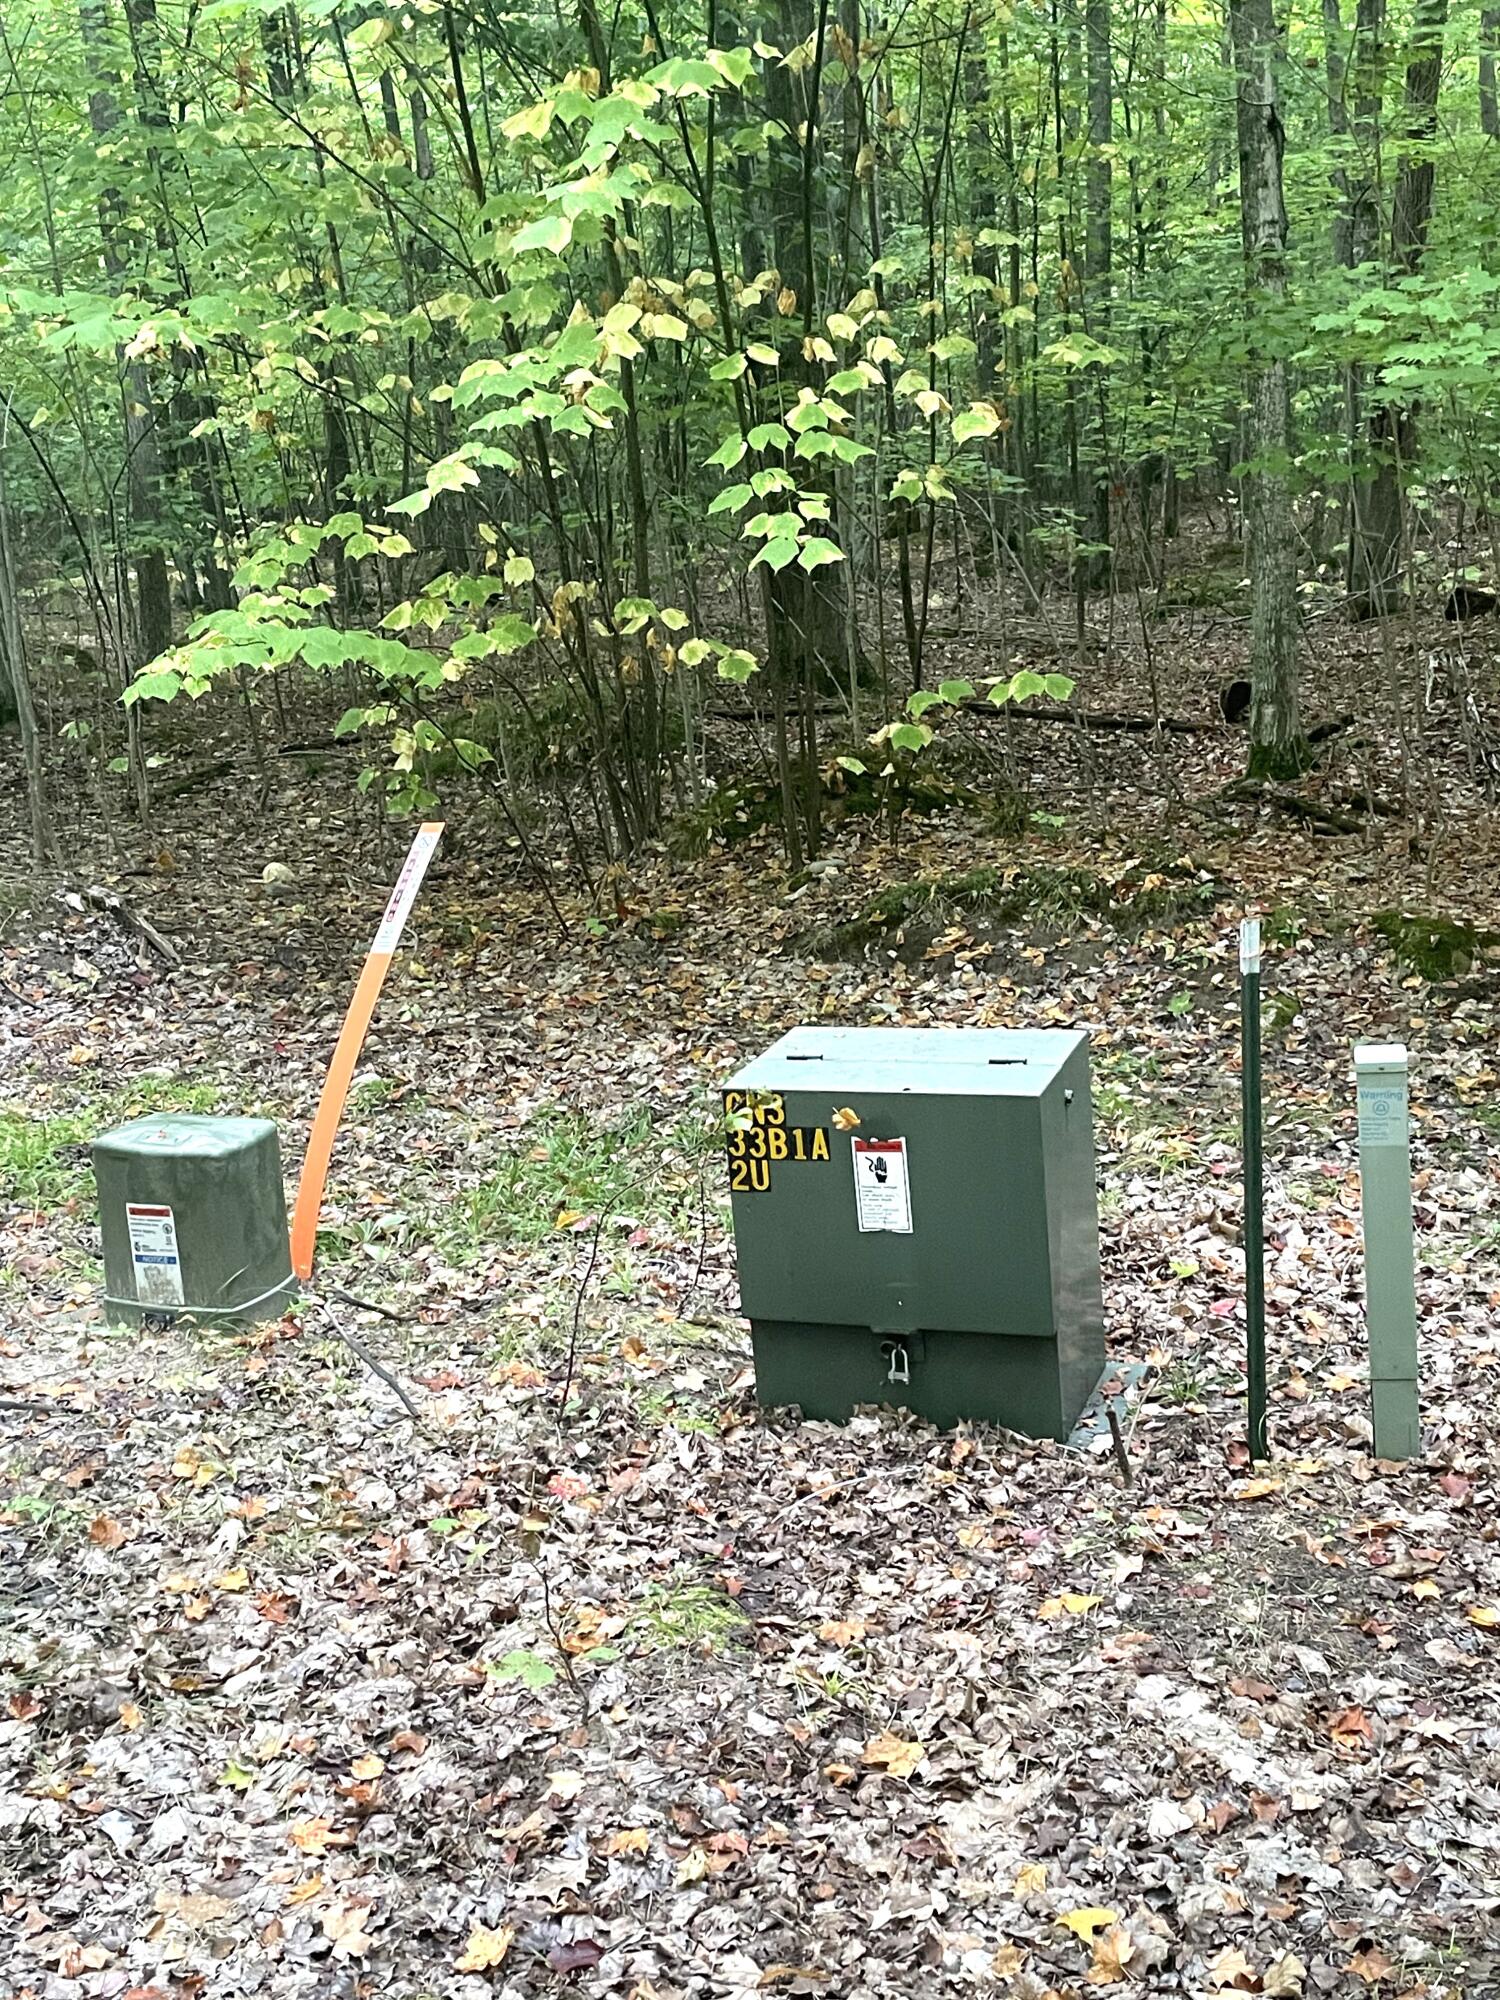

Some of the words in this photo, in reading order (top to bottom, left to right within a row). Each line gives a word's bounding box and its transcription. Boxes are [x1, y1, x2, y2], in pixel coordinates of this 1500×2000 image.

[1360, 1091, 1403, 1101] Warning
[728, 1127, 830, 1160] 33B1A
[731, 1159, 770, 1191] 2U
